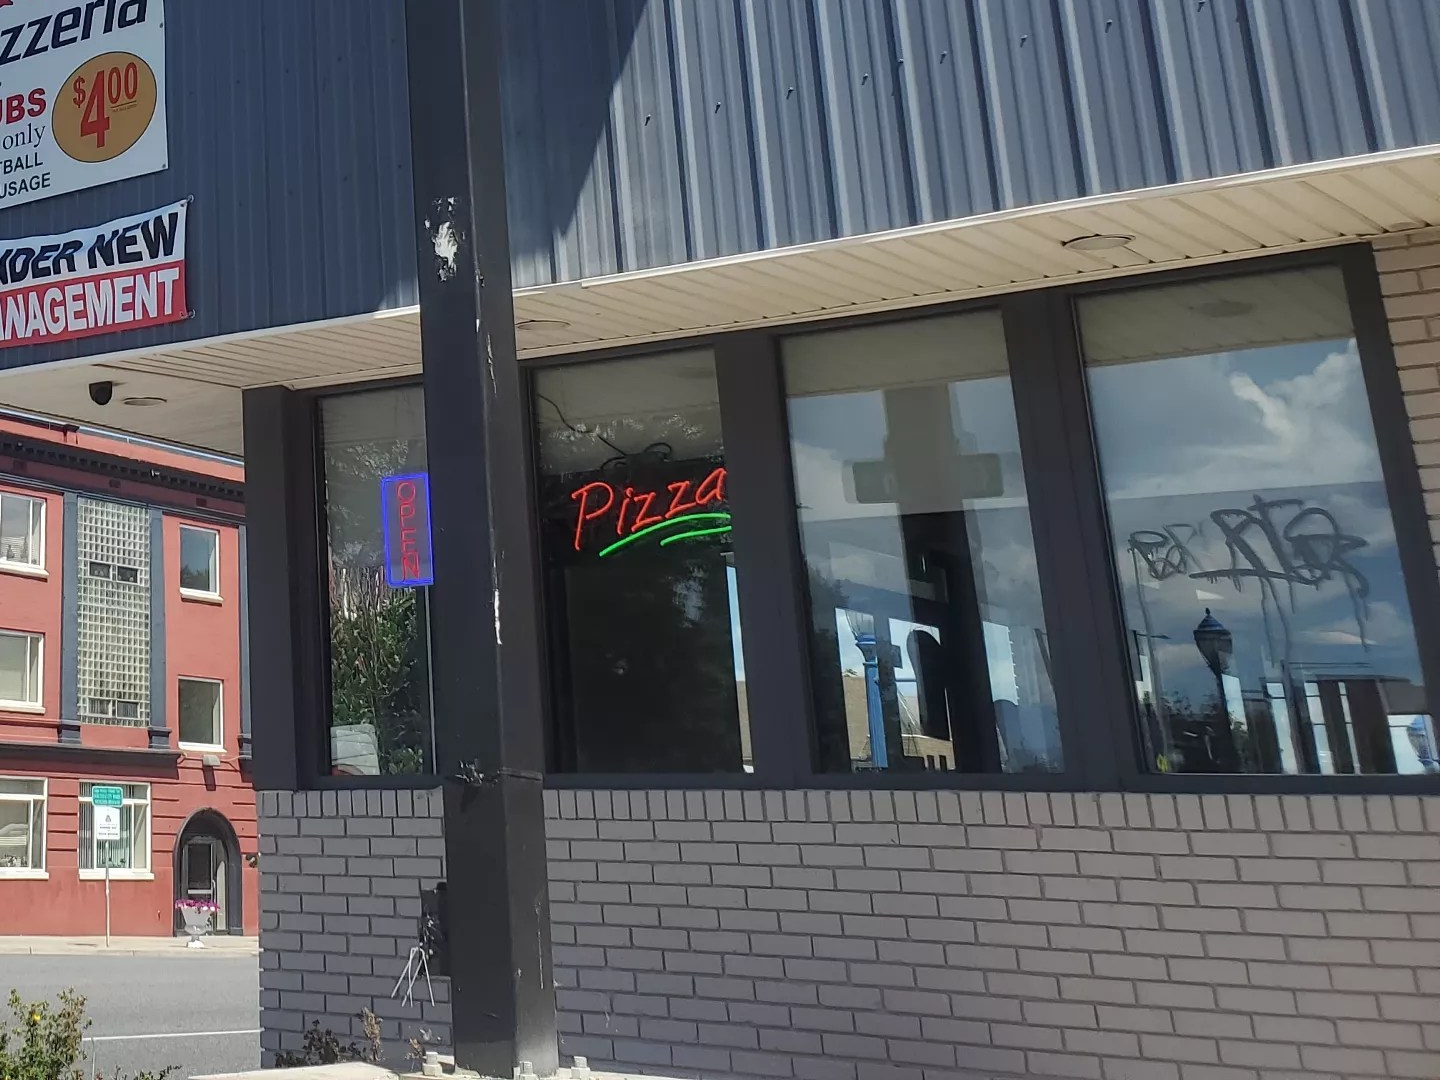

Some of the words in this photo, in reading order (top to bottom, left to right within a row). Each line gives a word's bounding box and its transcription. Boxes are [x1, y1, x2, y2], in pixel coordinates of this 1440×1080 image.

[2, 122, 46, 151] only
[87, 212, 179, 269] NEW
[396, 480, 420, 581] OPEN
[571, 468, 728, 551] Pizza
